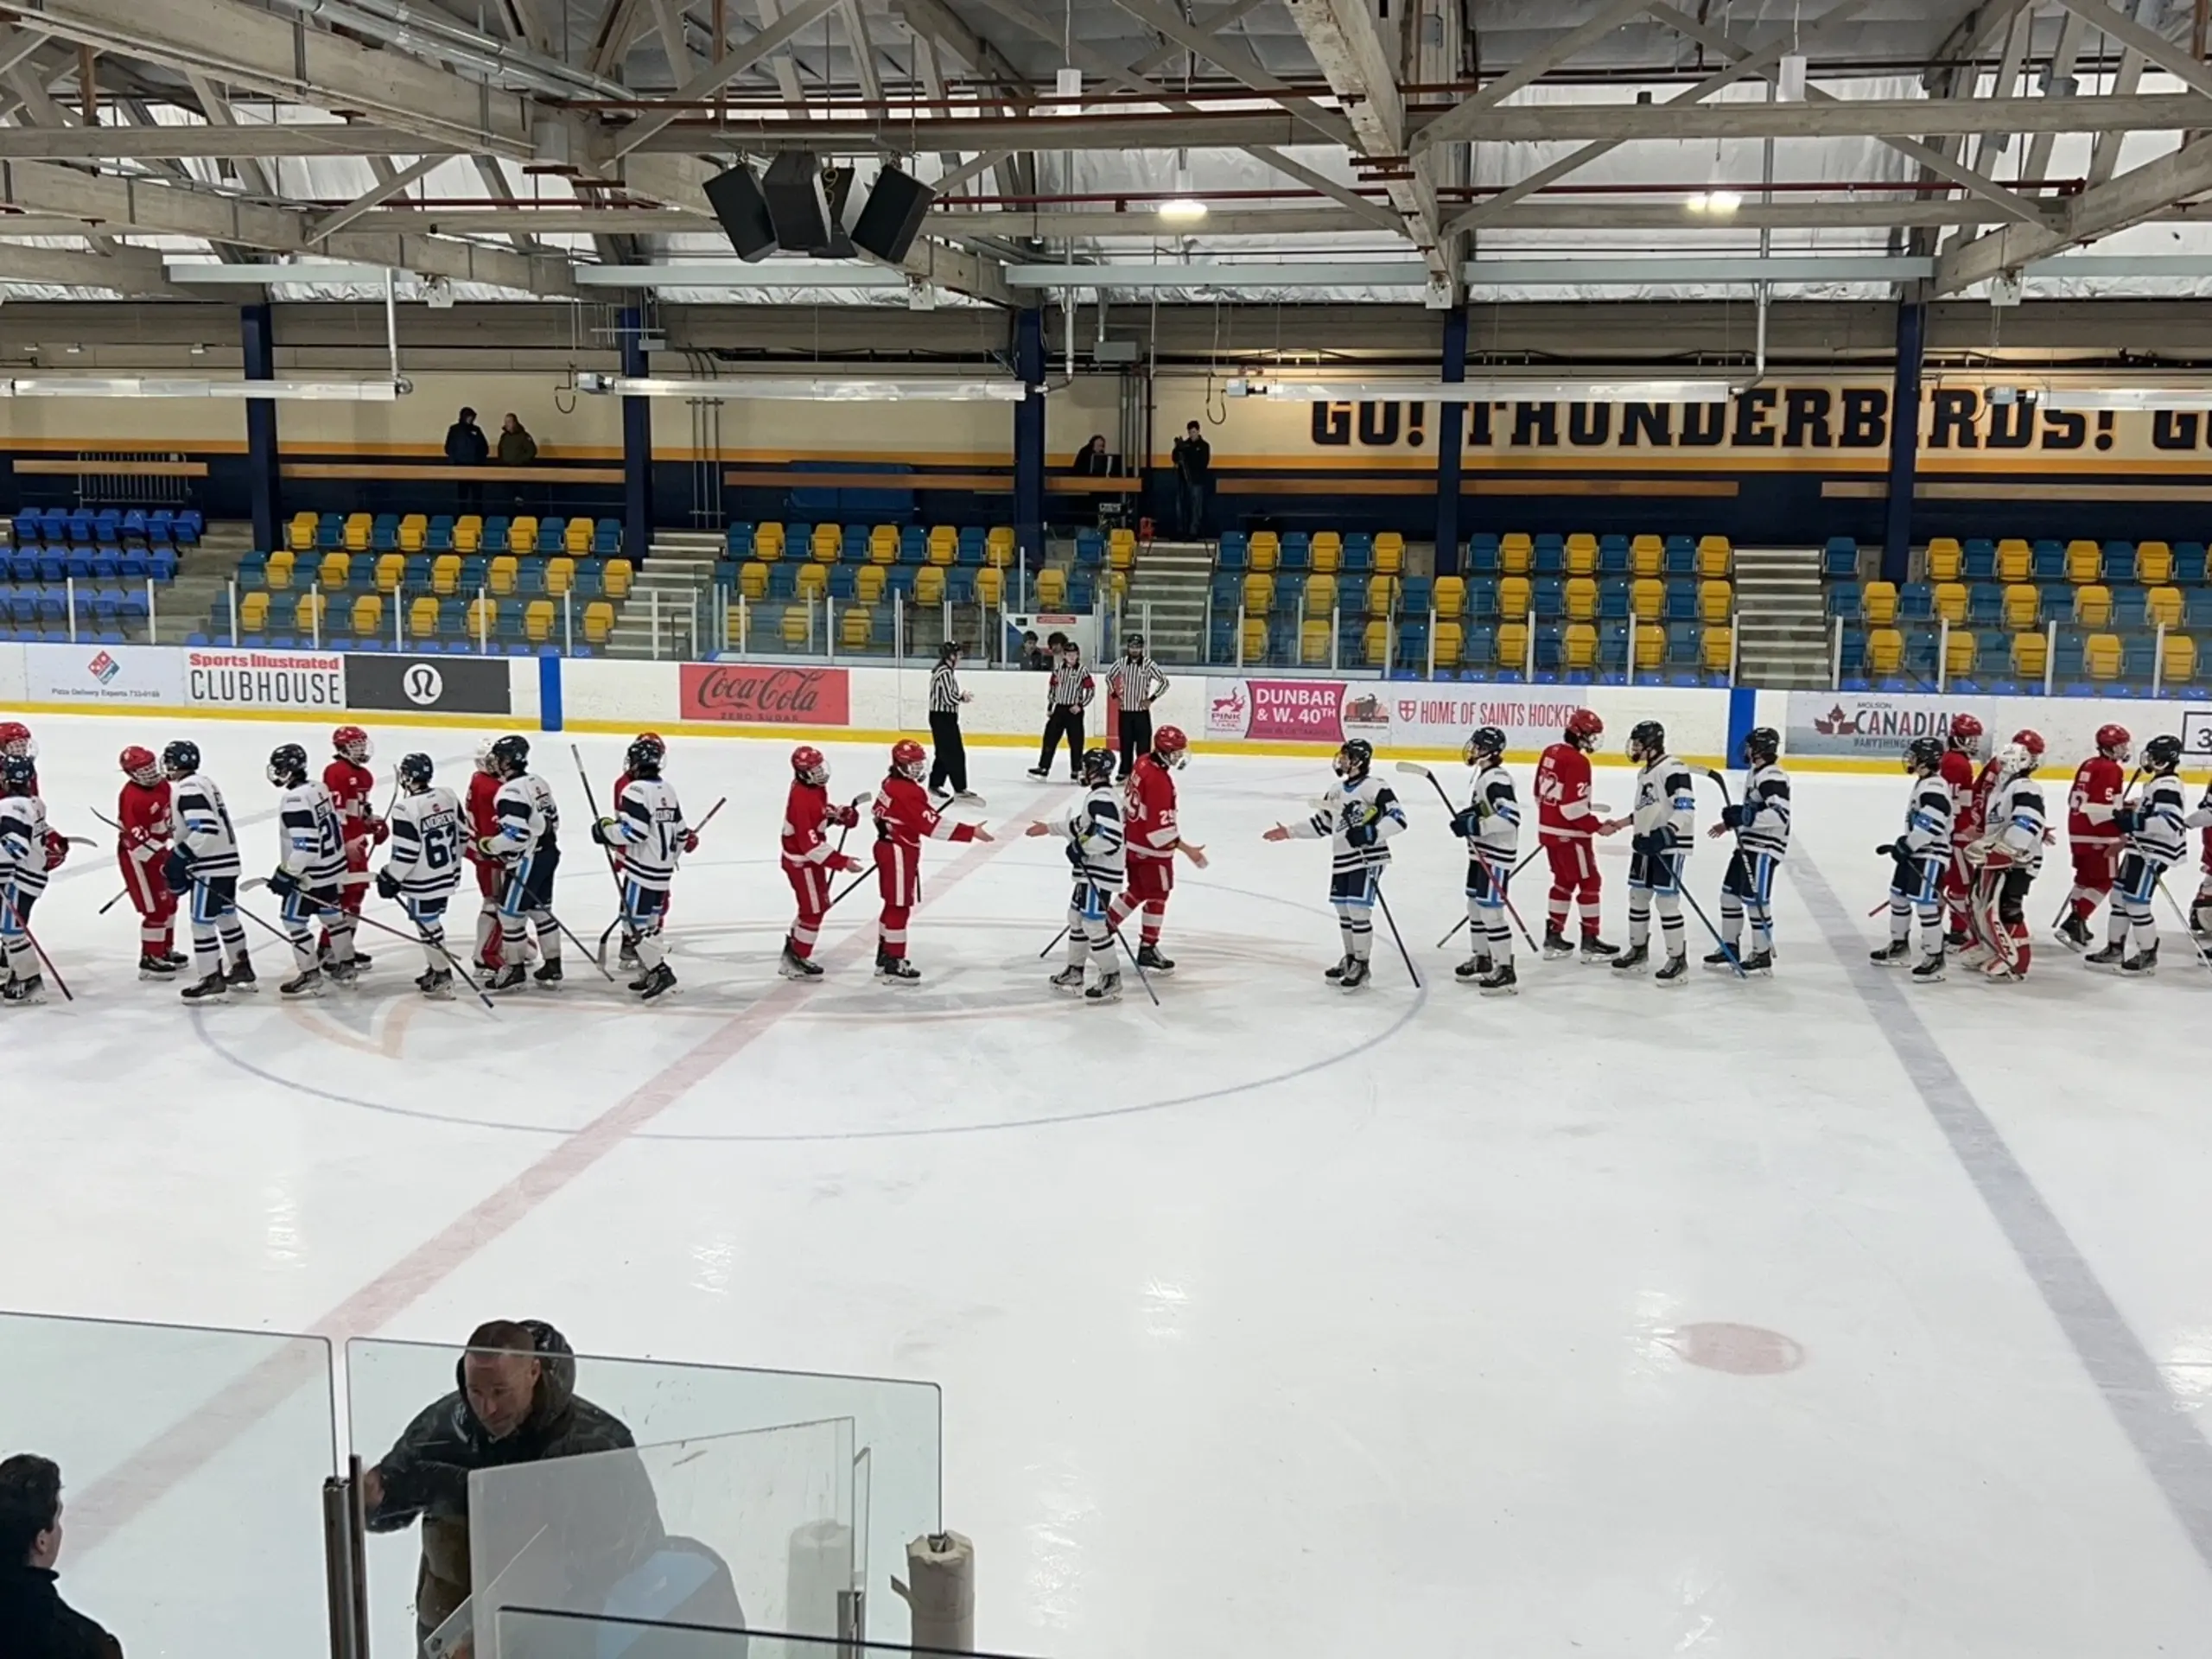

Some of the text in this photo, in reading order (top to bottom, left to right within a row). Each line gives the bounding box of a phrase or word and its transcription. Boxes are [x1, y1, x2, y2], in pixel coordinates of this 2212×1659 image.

[1465, 388, 2116, 450] THUNDERBRDS!
[189, 653, 340, 670] Sports Illustrated
[191, 670, 340, 704] CLUBHOUSE
[1256, 689, 1336, 706] DUNBAR
[1256, 707, 1336, 724] & W. 40TH
[1421, 701, 1457, 724] HOME
[1460, 702, 1477, 724] OF
[1480, 702, 1525, 726] SAINTS
[1855, 710, 1955, 736] CANADIA
